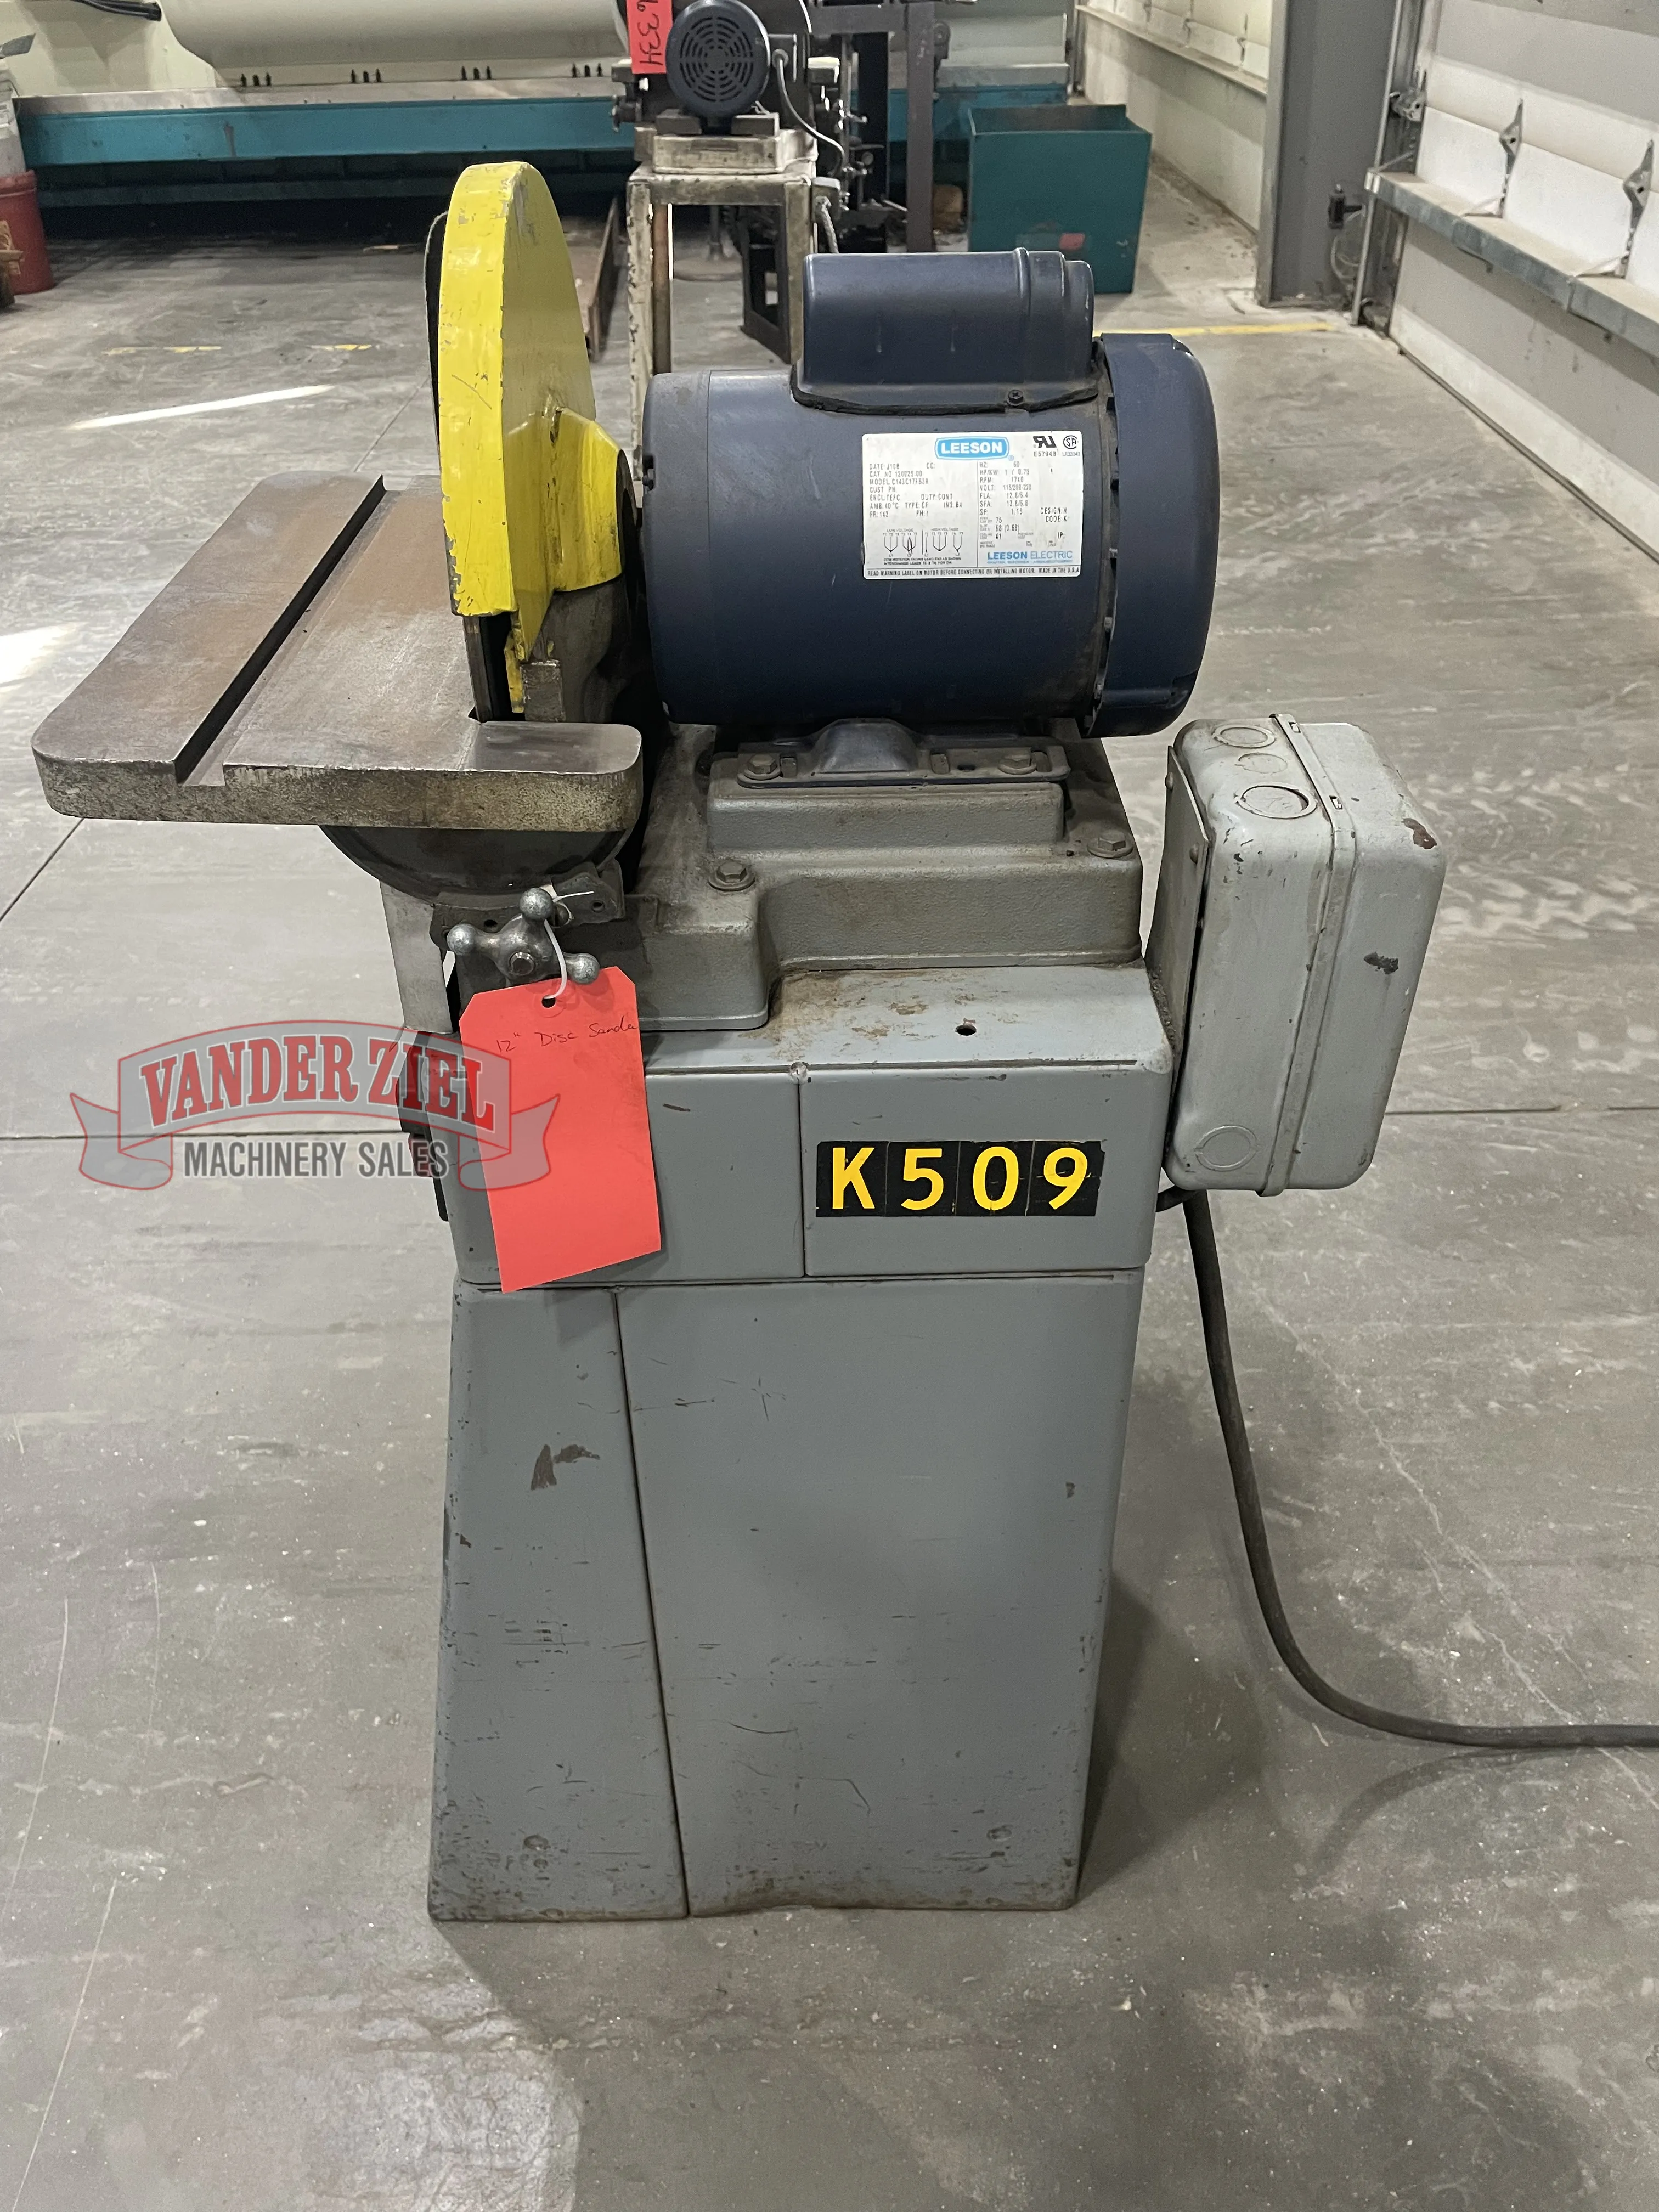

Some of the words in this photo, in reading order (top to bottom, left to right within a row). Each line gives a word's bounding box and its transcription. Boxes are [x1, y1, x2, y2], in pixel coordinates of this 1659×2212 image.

[941, 442, 1002, 454] LEESON
[988, 551, 1028, 560] LEESON
[1030, 550, 1073, 559] ELECTRIC
[533, 1031, 579, 1047] Disc
